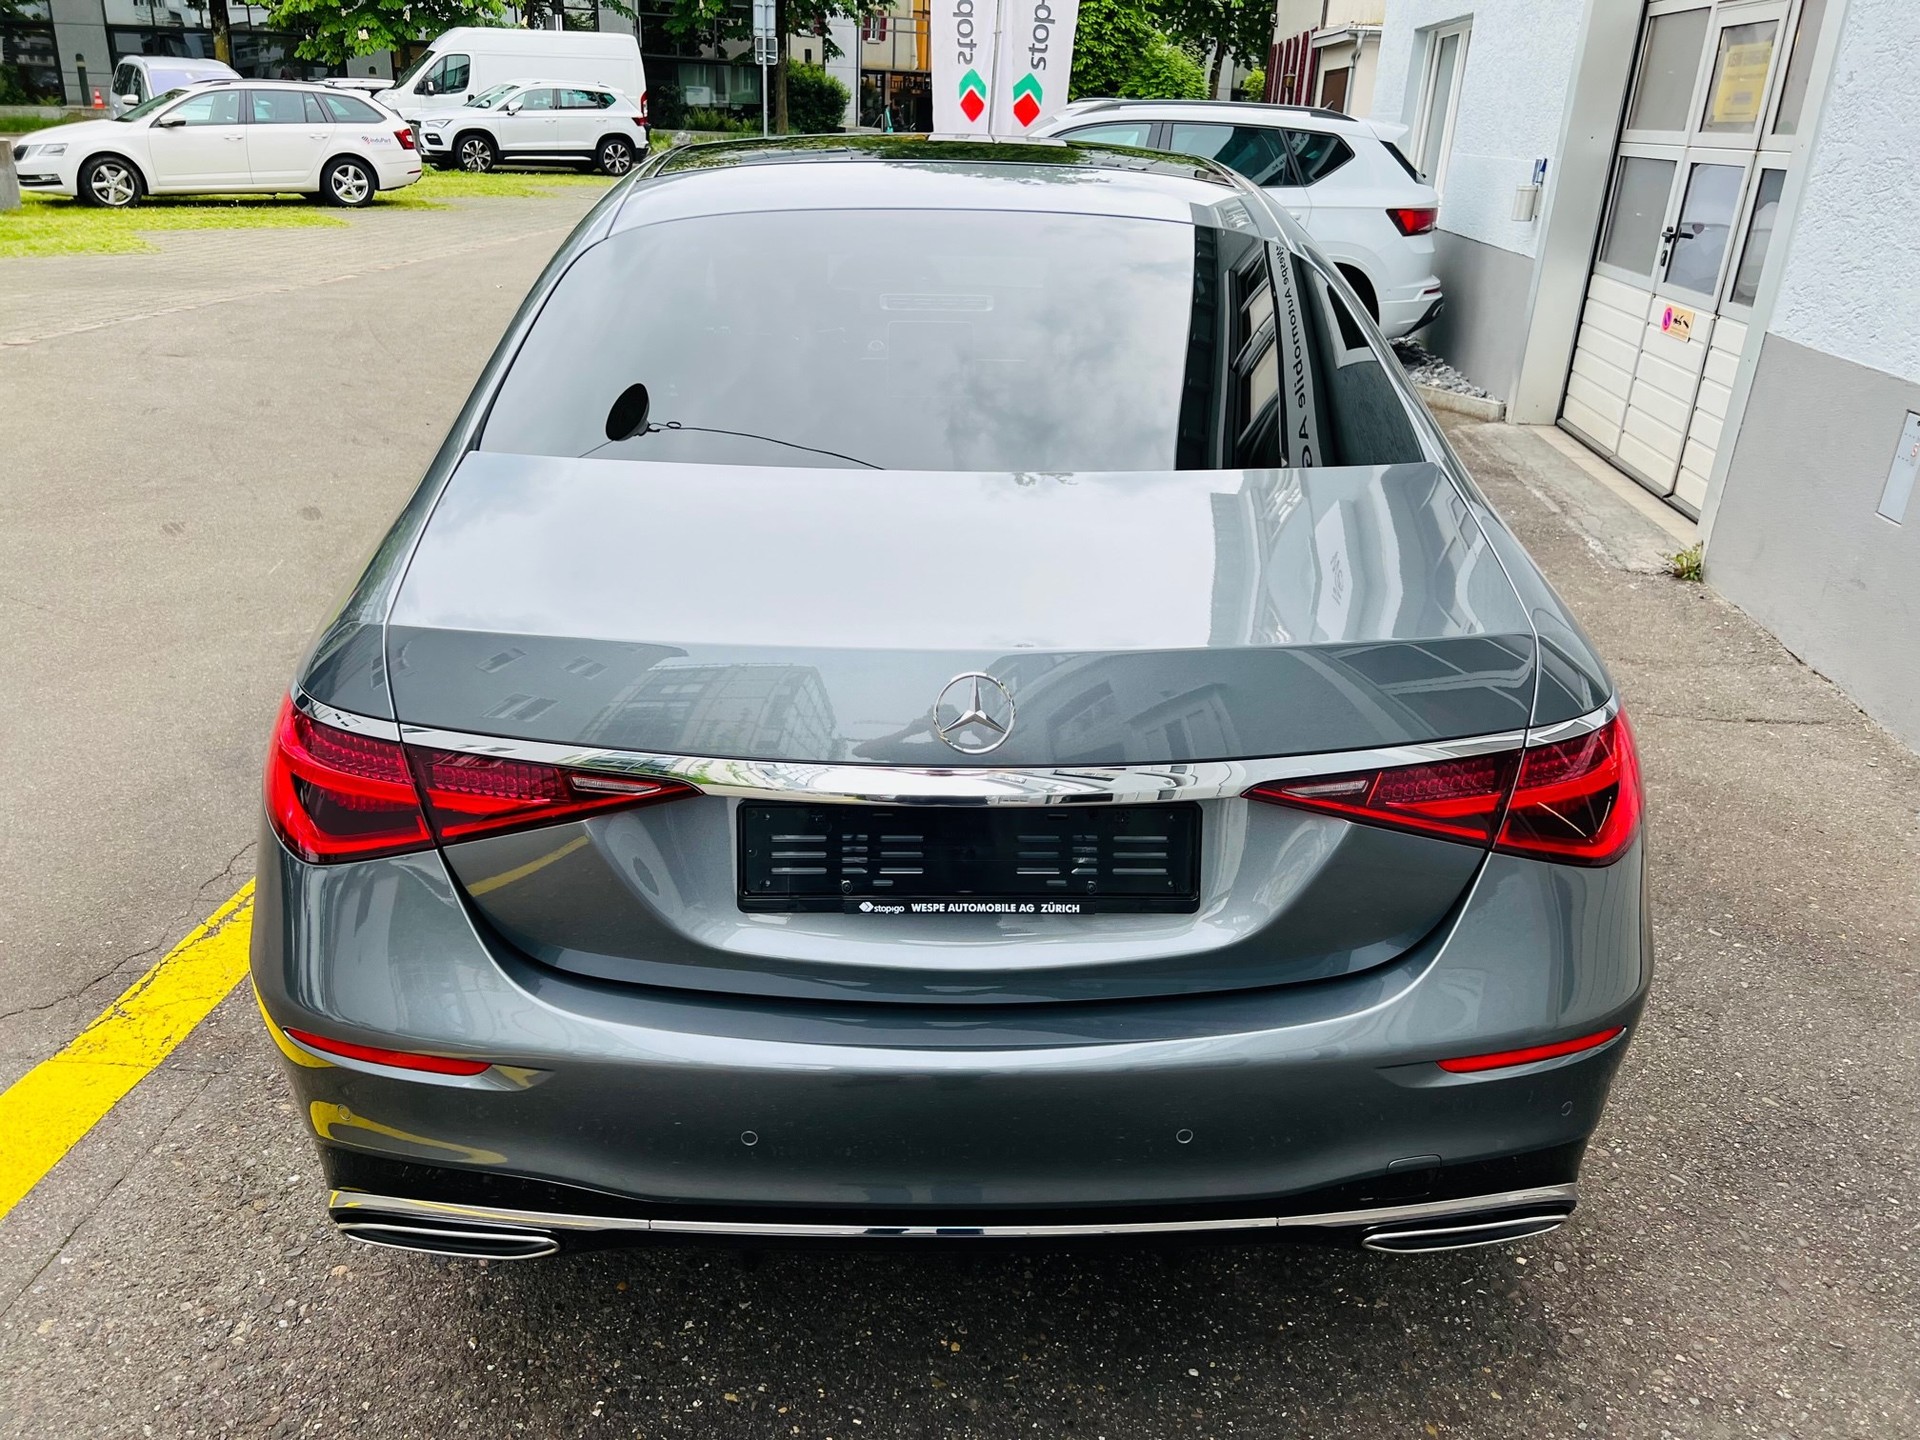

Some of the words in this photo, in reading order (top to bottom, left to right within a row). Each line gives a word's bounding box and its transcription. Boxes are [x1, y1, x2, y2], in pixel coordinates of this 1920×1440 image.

[911, 903, 945, 912] WESPE
[947, 903, 1017, 913] AUTOMOBILE
[1018, 903, 1035, 913] AG
[1040, 901, 1080, 913] ZÜRICH
